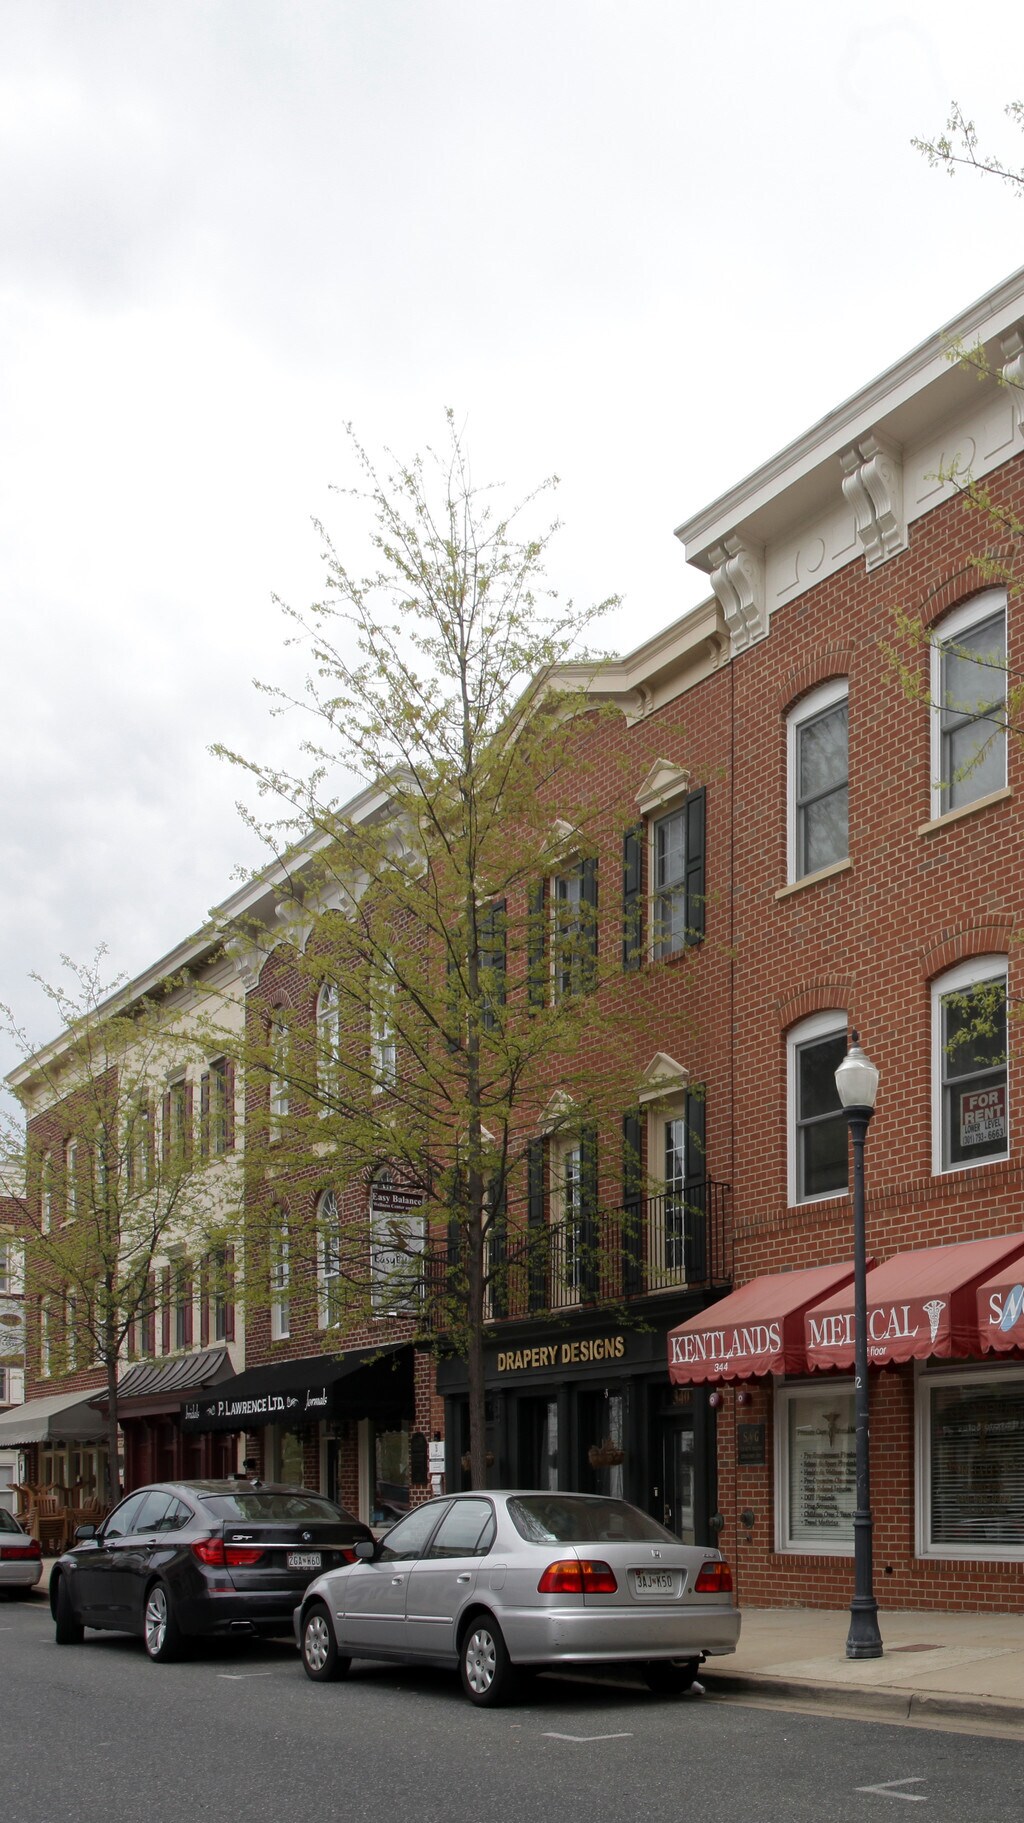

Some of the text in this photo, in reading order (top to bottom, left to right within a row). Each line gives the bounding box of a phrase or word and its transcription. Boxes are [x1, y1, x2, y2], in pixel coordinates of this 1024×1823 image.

[969, 1092, 999, 1110] FOR
[964, 1104, 1003, 1125] RENT
[964, 1118, 1001, 1134] LOWER LEVEL
[373, 1192, 422, 1206] Easy Balance
[807, 1305, 919, 1349] MEDCAL
[670, 1322, 781, 1364] KENTLANDS
[870, 1346, 887, 1357] floor
[498, 1336, 625, 1372] DRAPERY DESIGNS
[714, 1362, 728, 1373] 344
[218, 1394, 285, 1416] P. LAWRENCE LTD.
